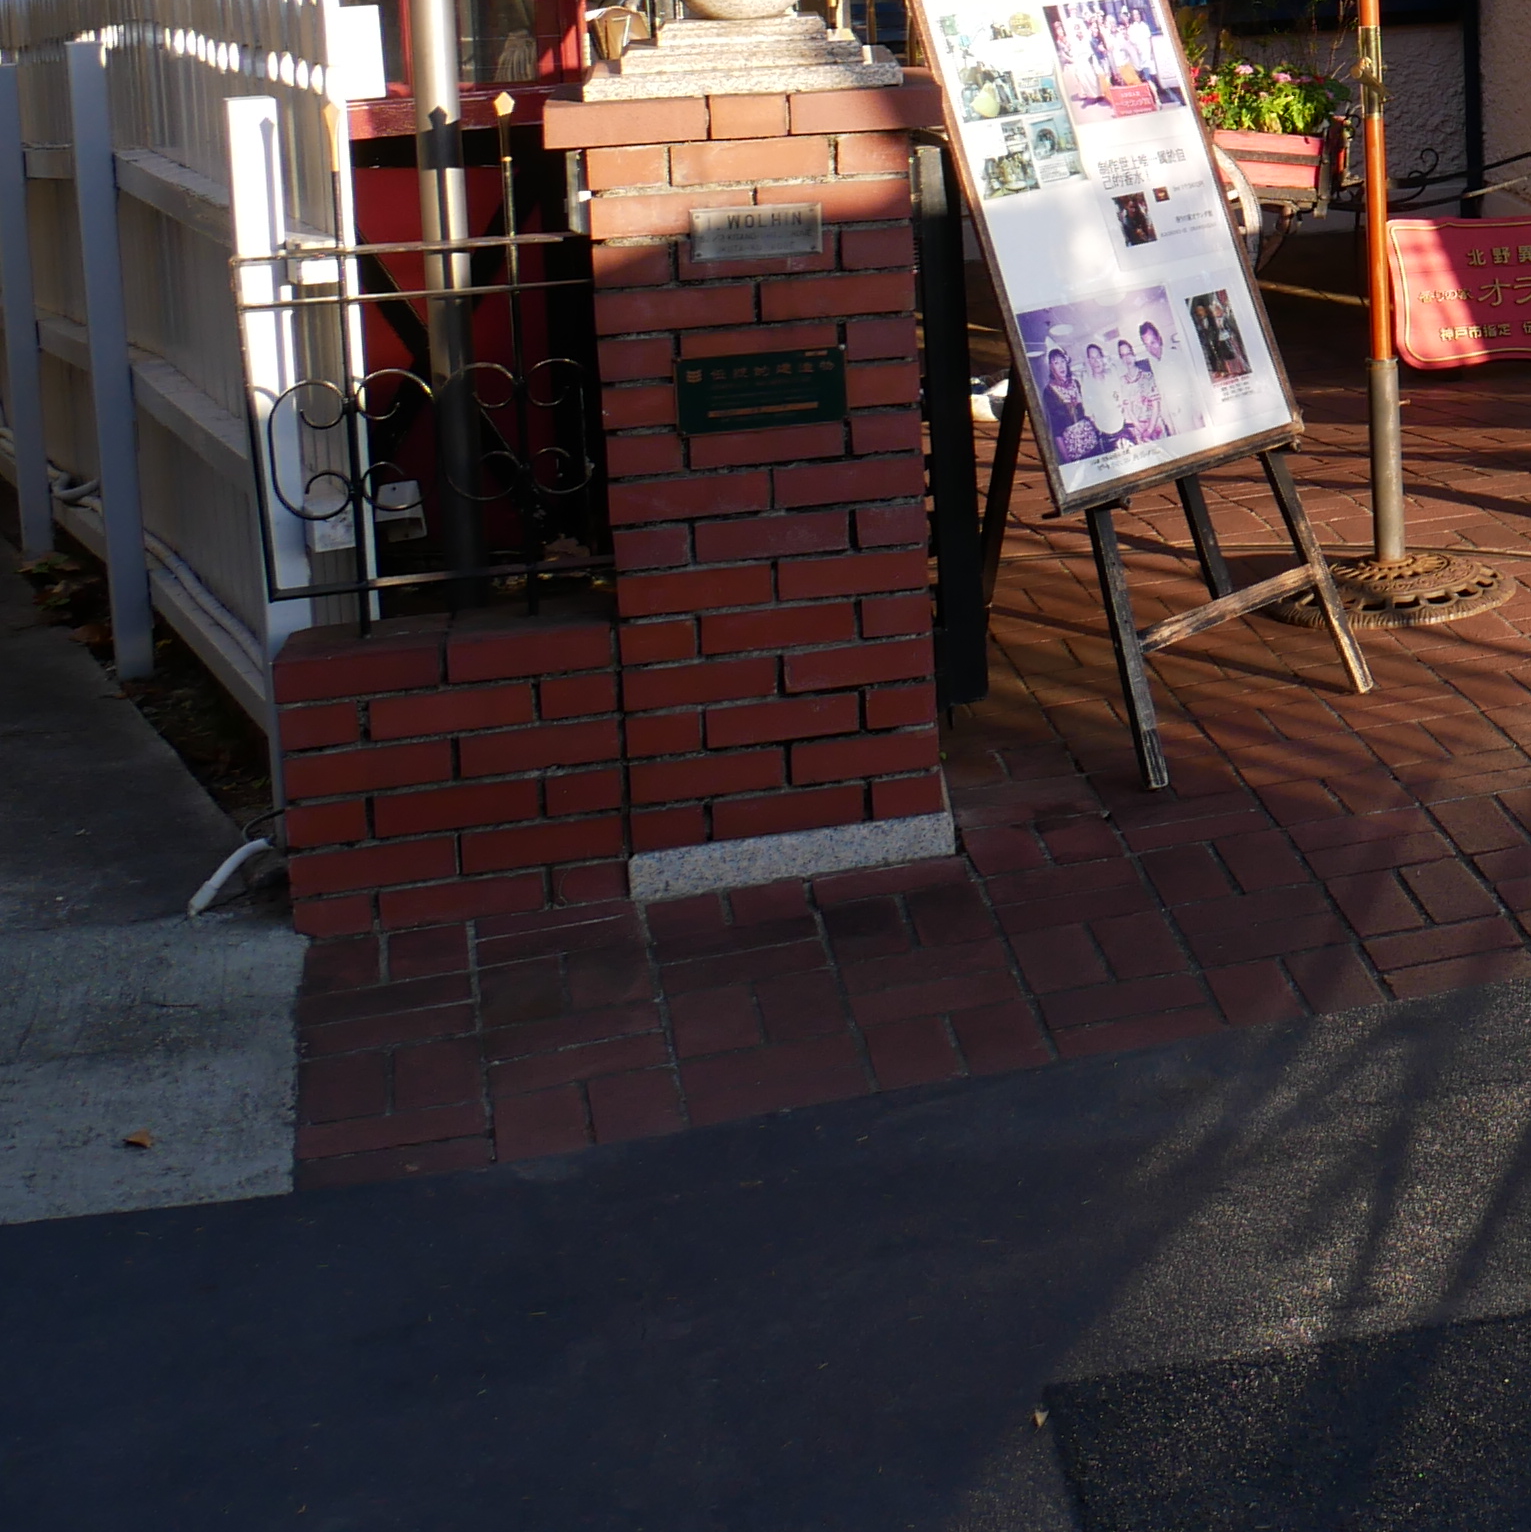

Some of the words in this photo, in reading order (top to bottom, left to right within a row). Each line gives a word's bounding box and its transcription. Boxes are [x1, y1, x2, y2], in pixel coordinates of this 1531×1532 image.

[727, 211, 802, 229] WOLHIN
[1439, 323, 1512, 342] 神戸市指定
